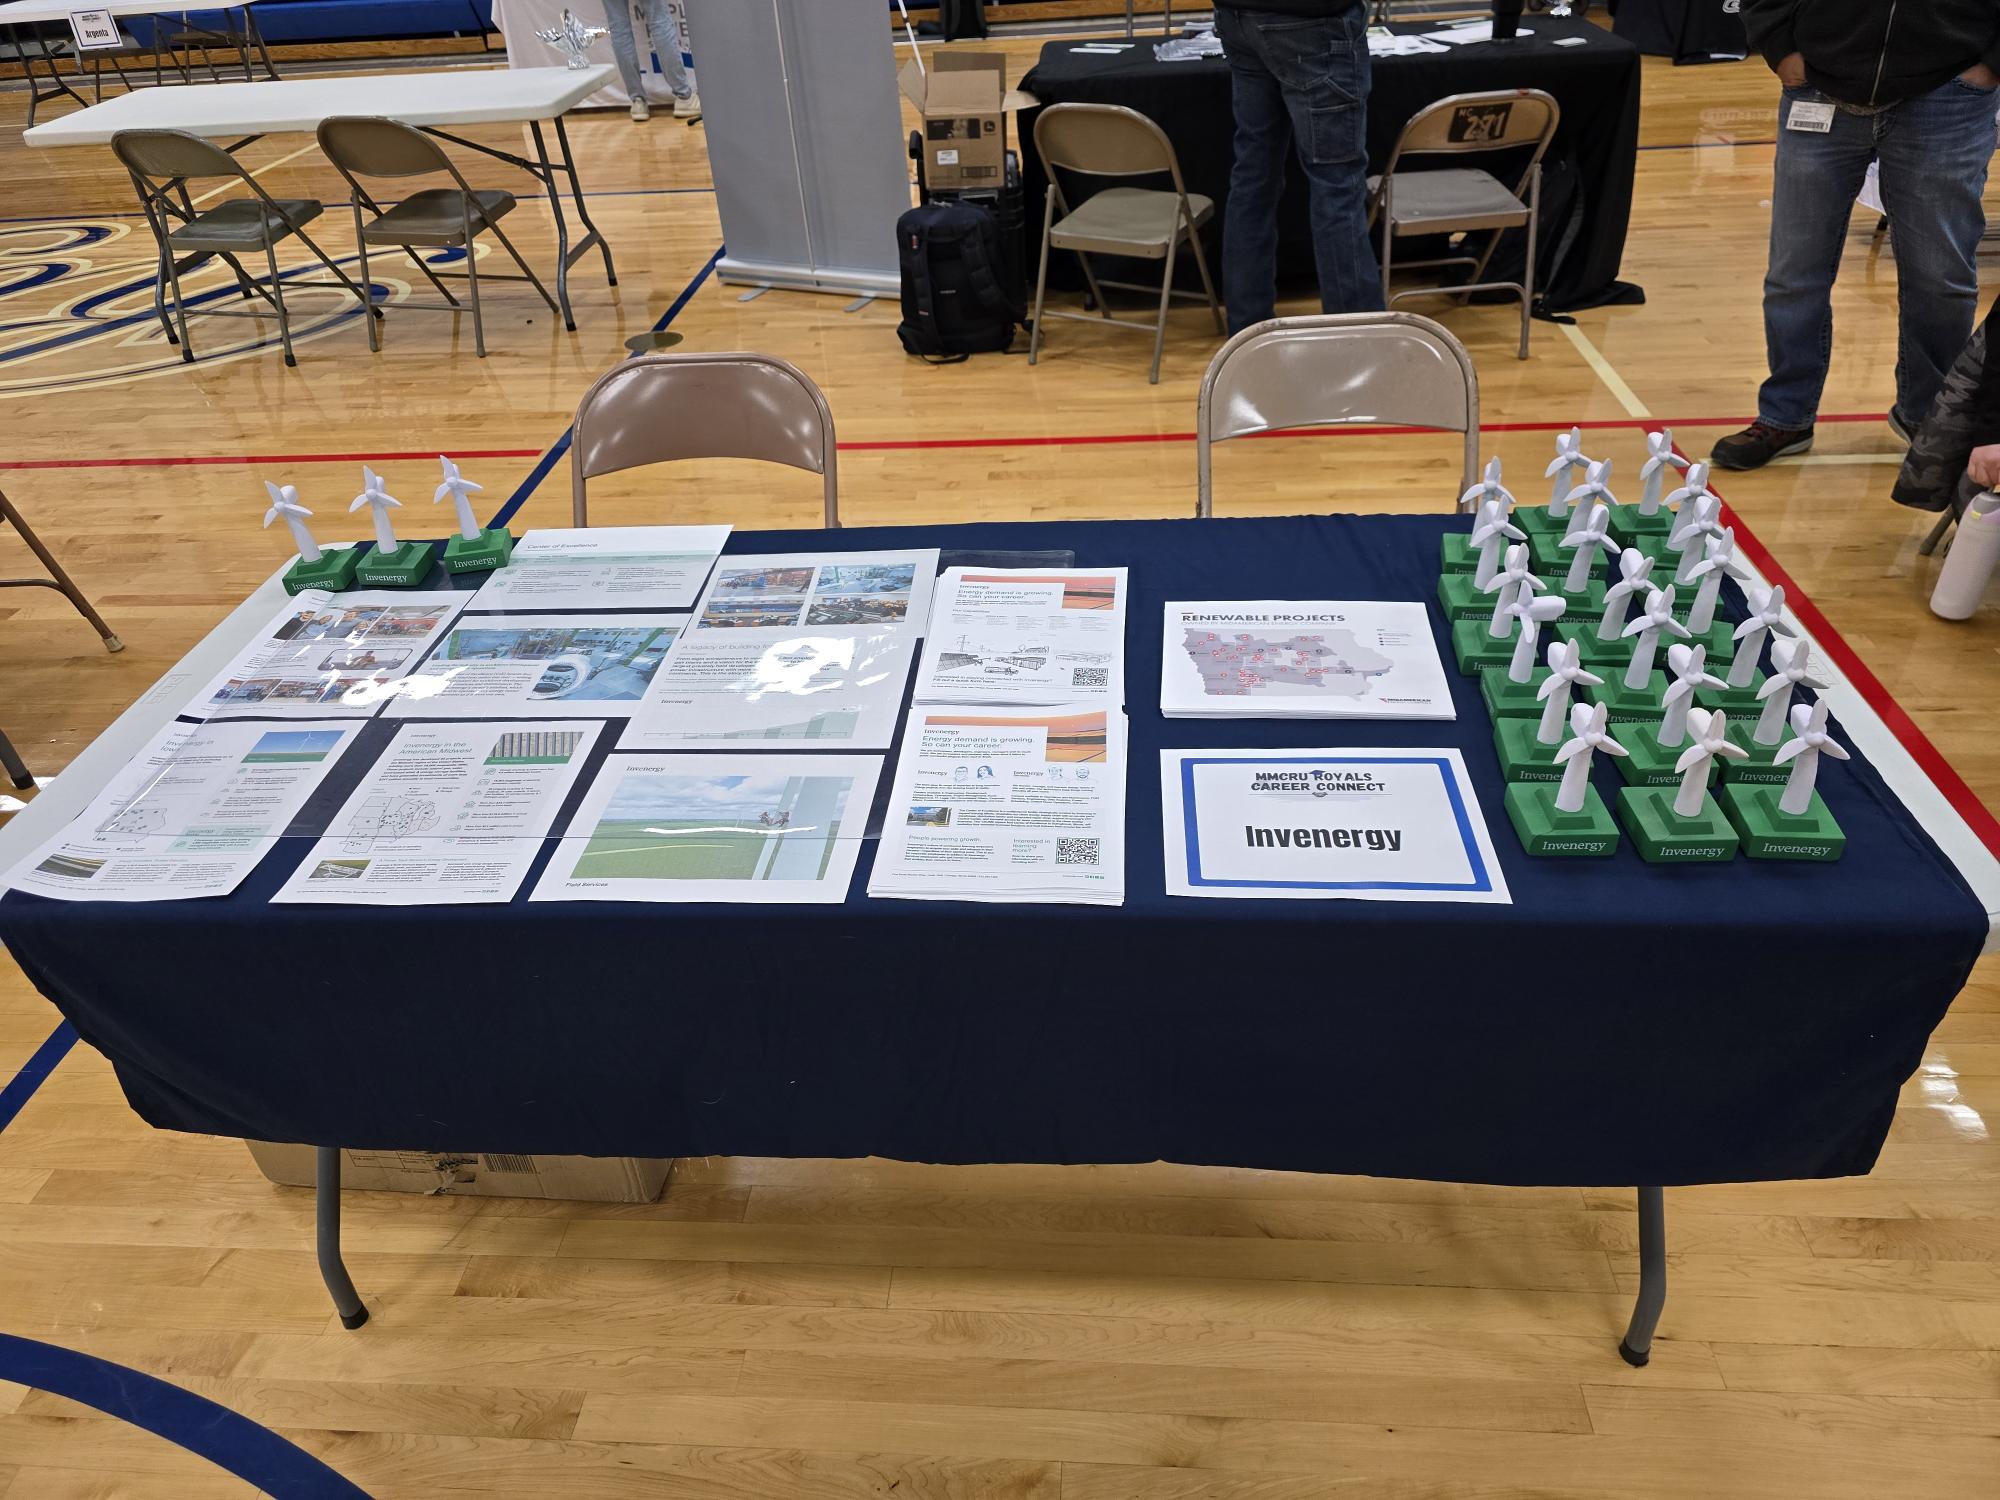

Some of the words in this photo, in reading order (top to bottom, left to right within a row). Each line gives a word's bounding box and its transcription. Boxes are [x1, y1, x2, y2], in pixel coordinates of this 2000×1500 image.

[85, 29, 109, 38] Argenta
[454, 556, 498, 568] Invenergy
[364, 573, 408, 583] Invenergy
[292, 578, 335, 591] Invenergy
[1182, 614, 1269, 622] RENEWABLE
[1273, 614, 1346, 622] PROJECTS
[922, 735, 952, 743] Energy
[1255, 772, 1308, 781] MMCRU
[1314, 772, 1372, 781] ROYALS
[1251, 782, 1311, 791] CAREER
[1316, 782, 1385, 792] CONNECT
[1245, 825, 1401, 852] Invenergy
[1542, 841, 1607, 852] Invenergy
[1660, 845, 1725, 857] Invenergy
[1762, 843, 1831, 855] Invenergy
